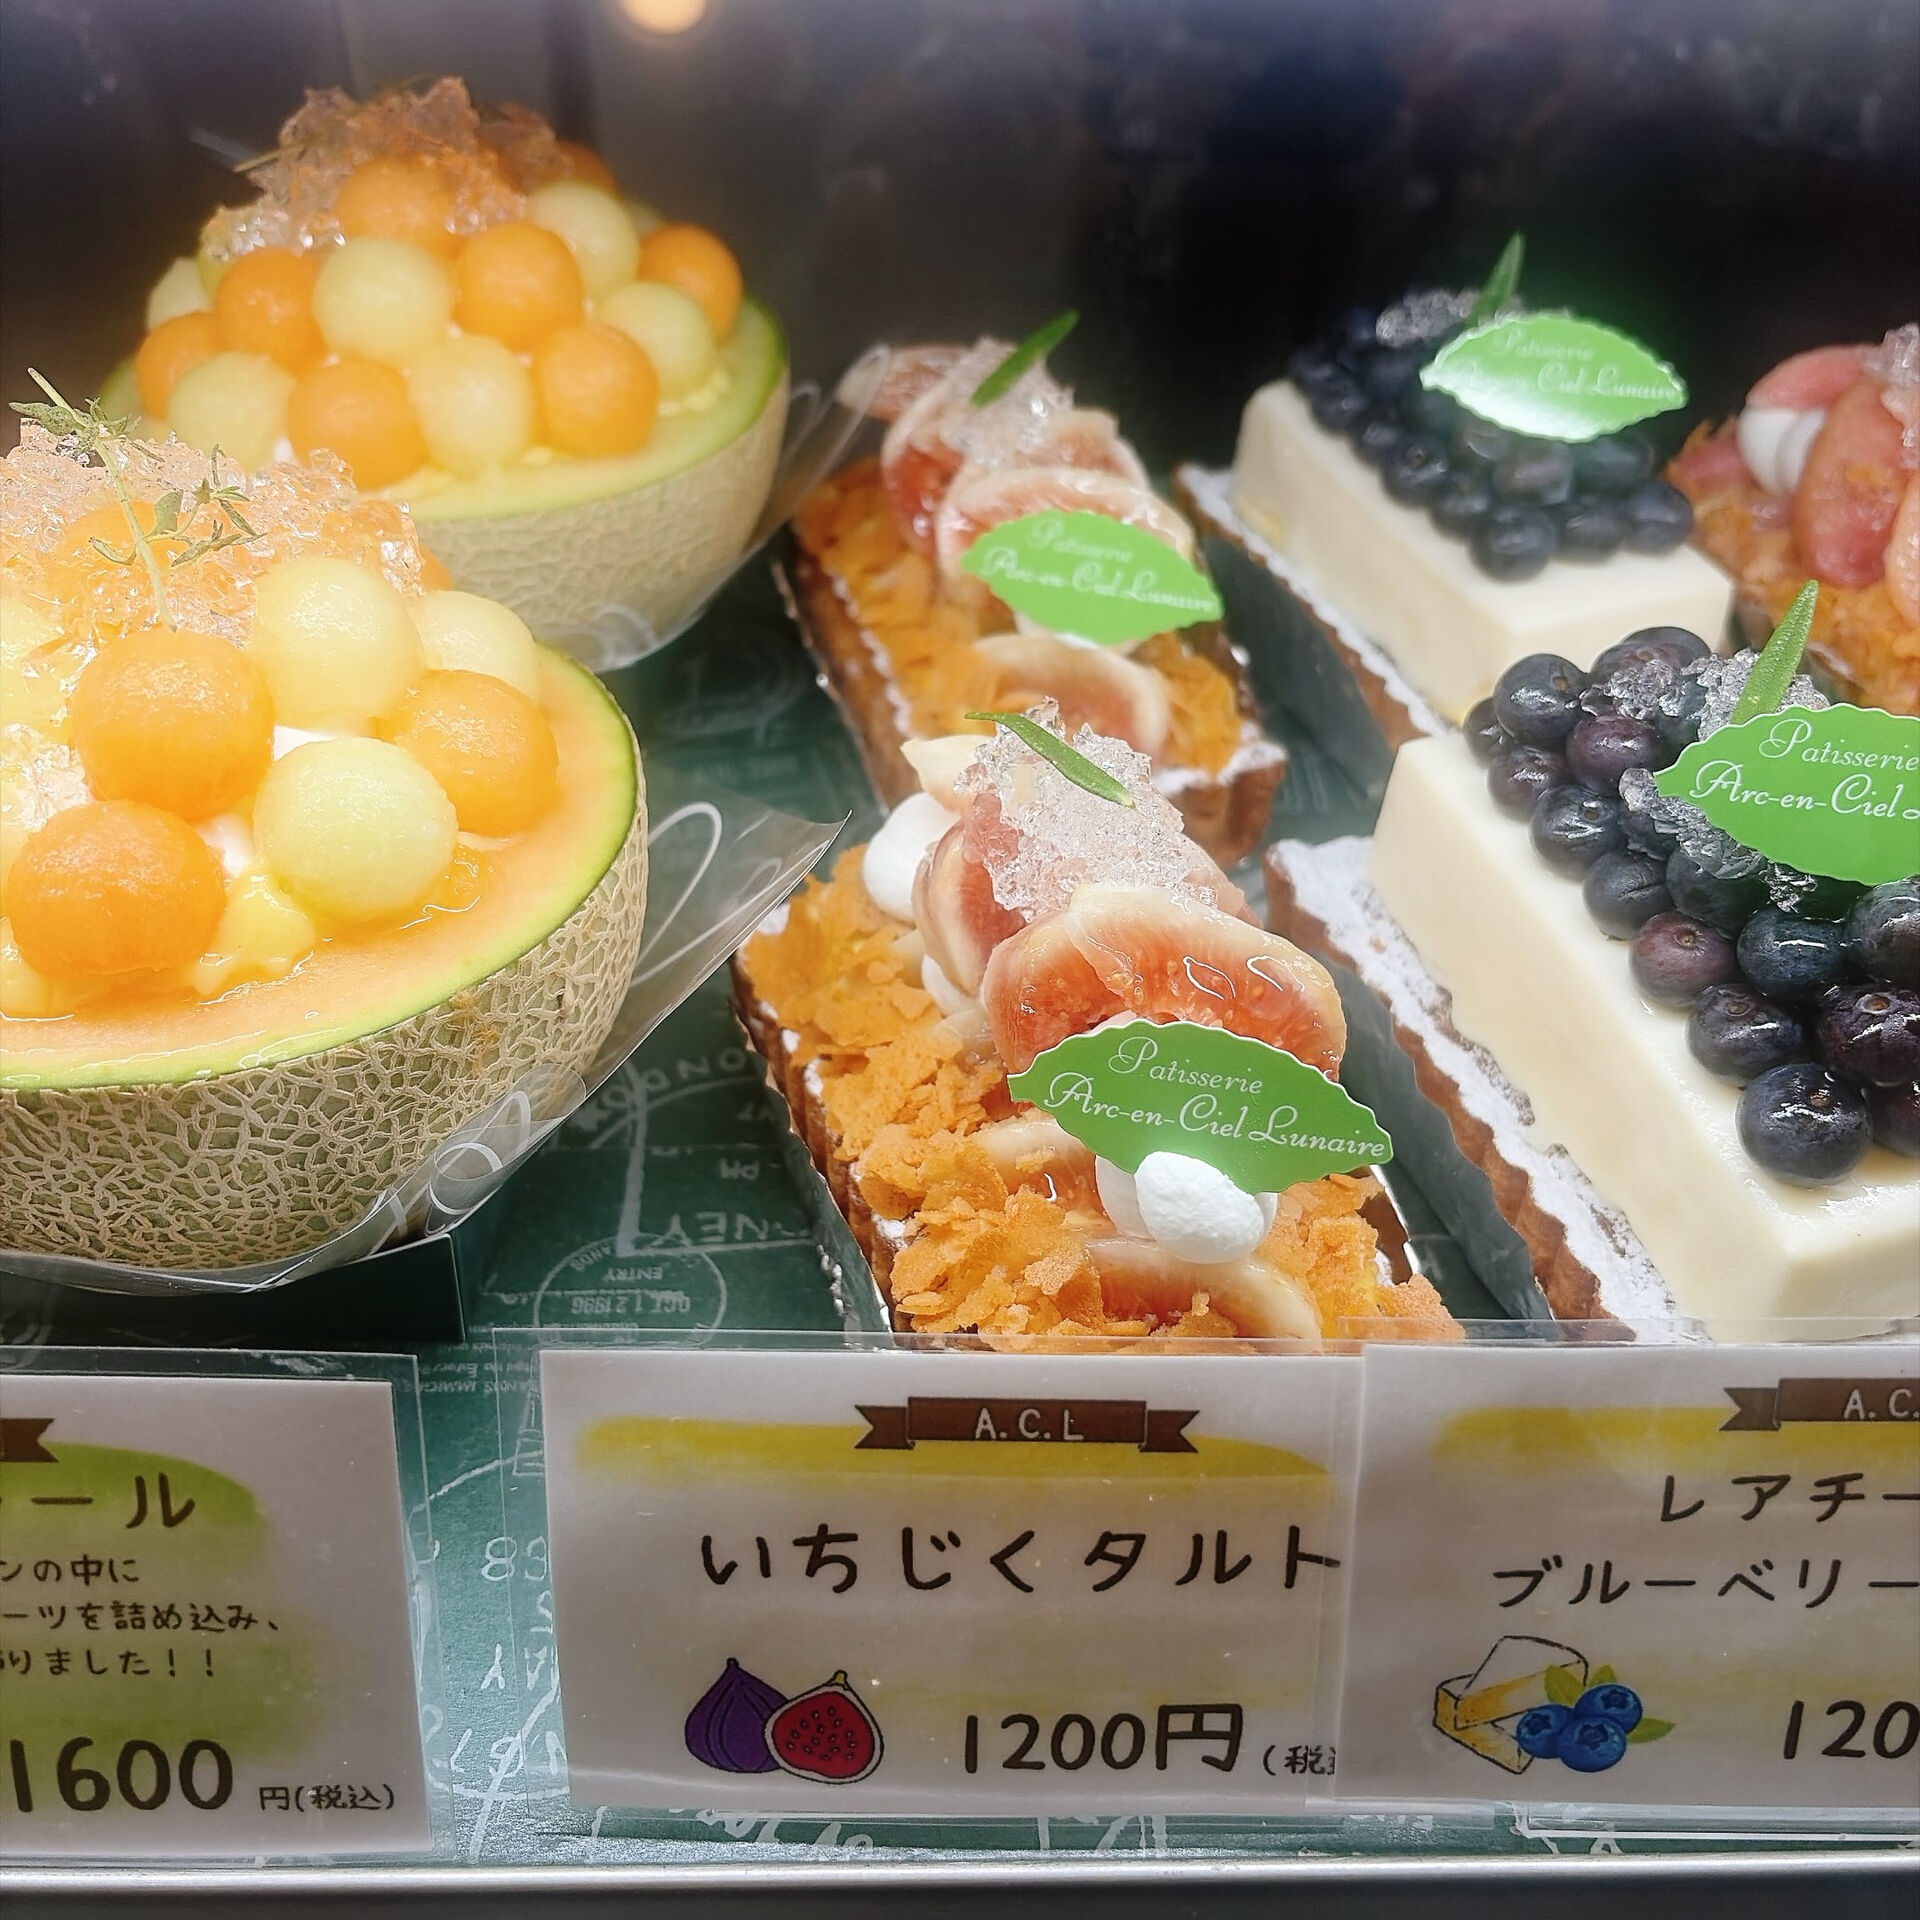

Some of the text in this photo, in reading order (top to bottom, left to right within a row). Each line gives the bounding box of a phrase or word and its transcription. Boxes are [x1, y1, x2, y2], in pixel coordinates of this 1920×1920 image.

[1758, 718, 1920, 772] Patisserie
[1689, 759, 1904, 819] Arc-en-Ciel
[1107, 1035, 1264, 1095] Patisserie
[1043, 1071, 1385, 1158] Arc-en-Ciel Lunaire
[601, 1266, 664, 1282] ENTRY
[973, 1404, 1085, 1442] A.C.L
[0, 1471, 196, 1529] ール
[1659, 1472, 1920, 1523] レアチー
[0, 1554, 140, 1587] ンの中に
[700, 1522, 1342, 1595] いちじくタルト
[1492, 1553, 1920, 1609] ブルーベリー
[0, 1648, 216, 1678] りました！！
[962, 1702, 1244, 1774] 1200円
[1782, 1700, 1920, 1760] 120
[9, 1736, 397, 1814] 1600 円(税込)
